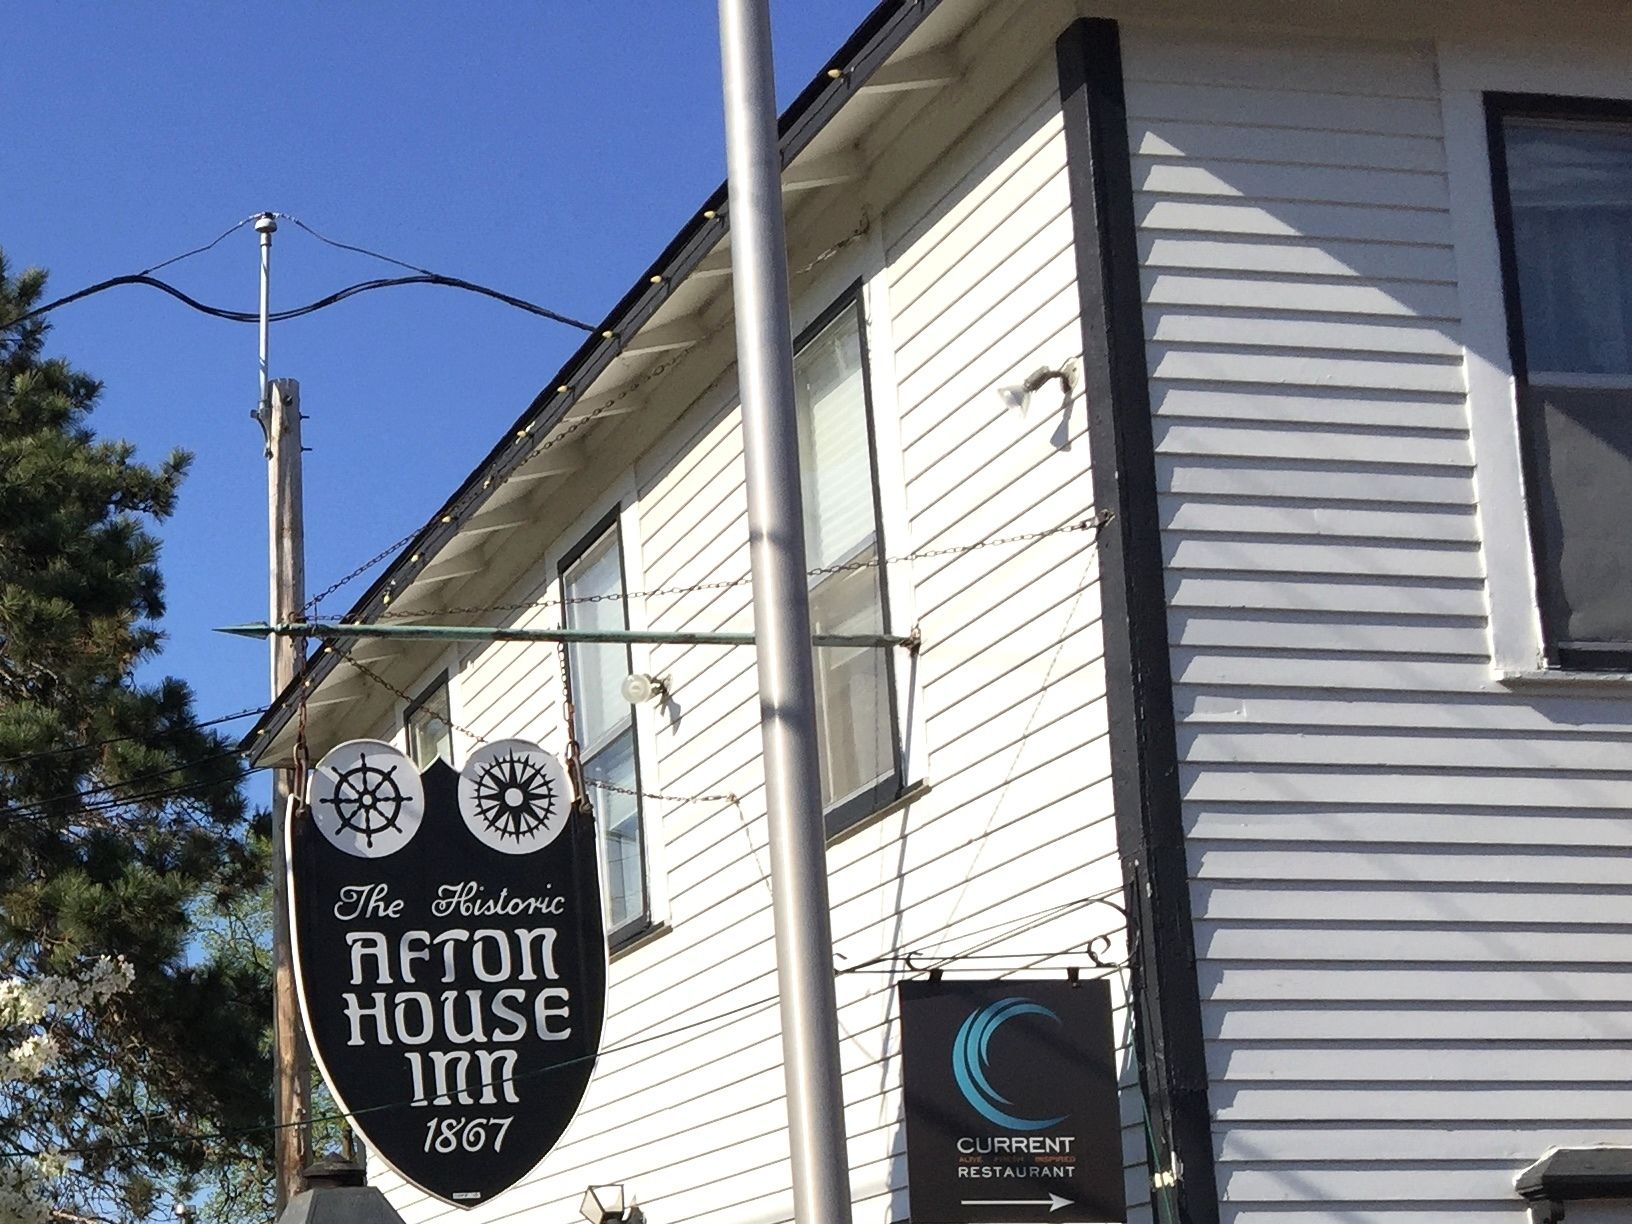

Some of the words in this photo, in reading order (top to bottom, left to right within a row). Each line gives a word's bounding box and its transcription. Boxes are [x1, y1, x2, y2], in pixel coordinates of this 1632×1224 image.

[333, 882, 404, 919] The
[431, 880, 565, 918] Historic
[344, 927, 561, 985] AFTON
[342, 987, 572, 1047] HOUSE
[404, 1049, 520, 1107] INN
[424, 1114, 515, 1154] 1867
[956, 1136, 1076, 1154] CURRENT
[957, 1166, 1076, 1178] RESTAURANT
